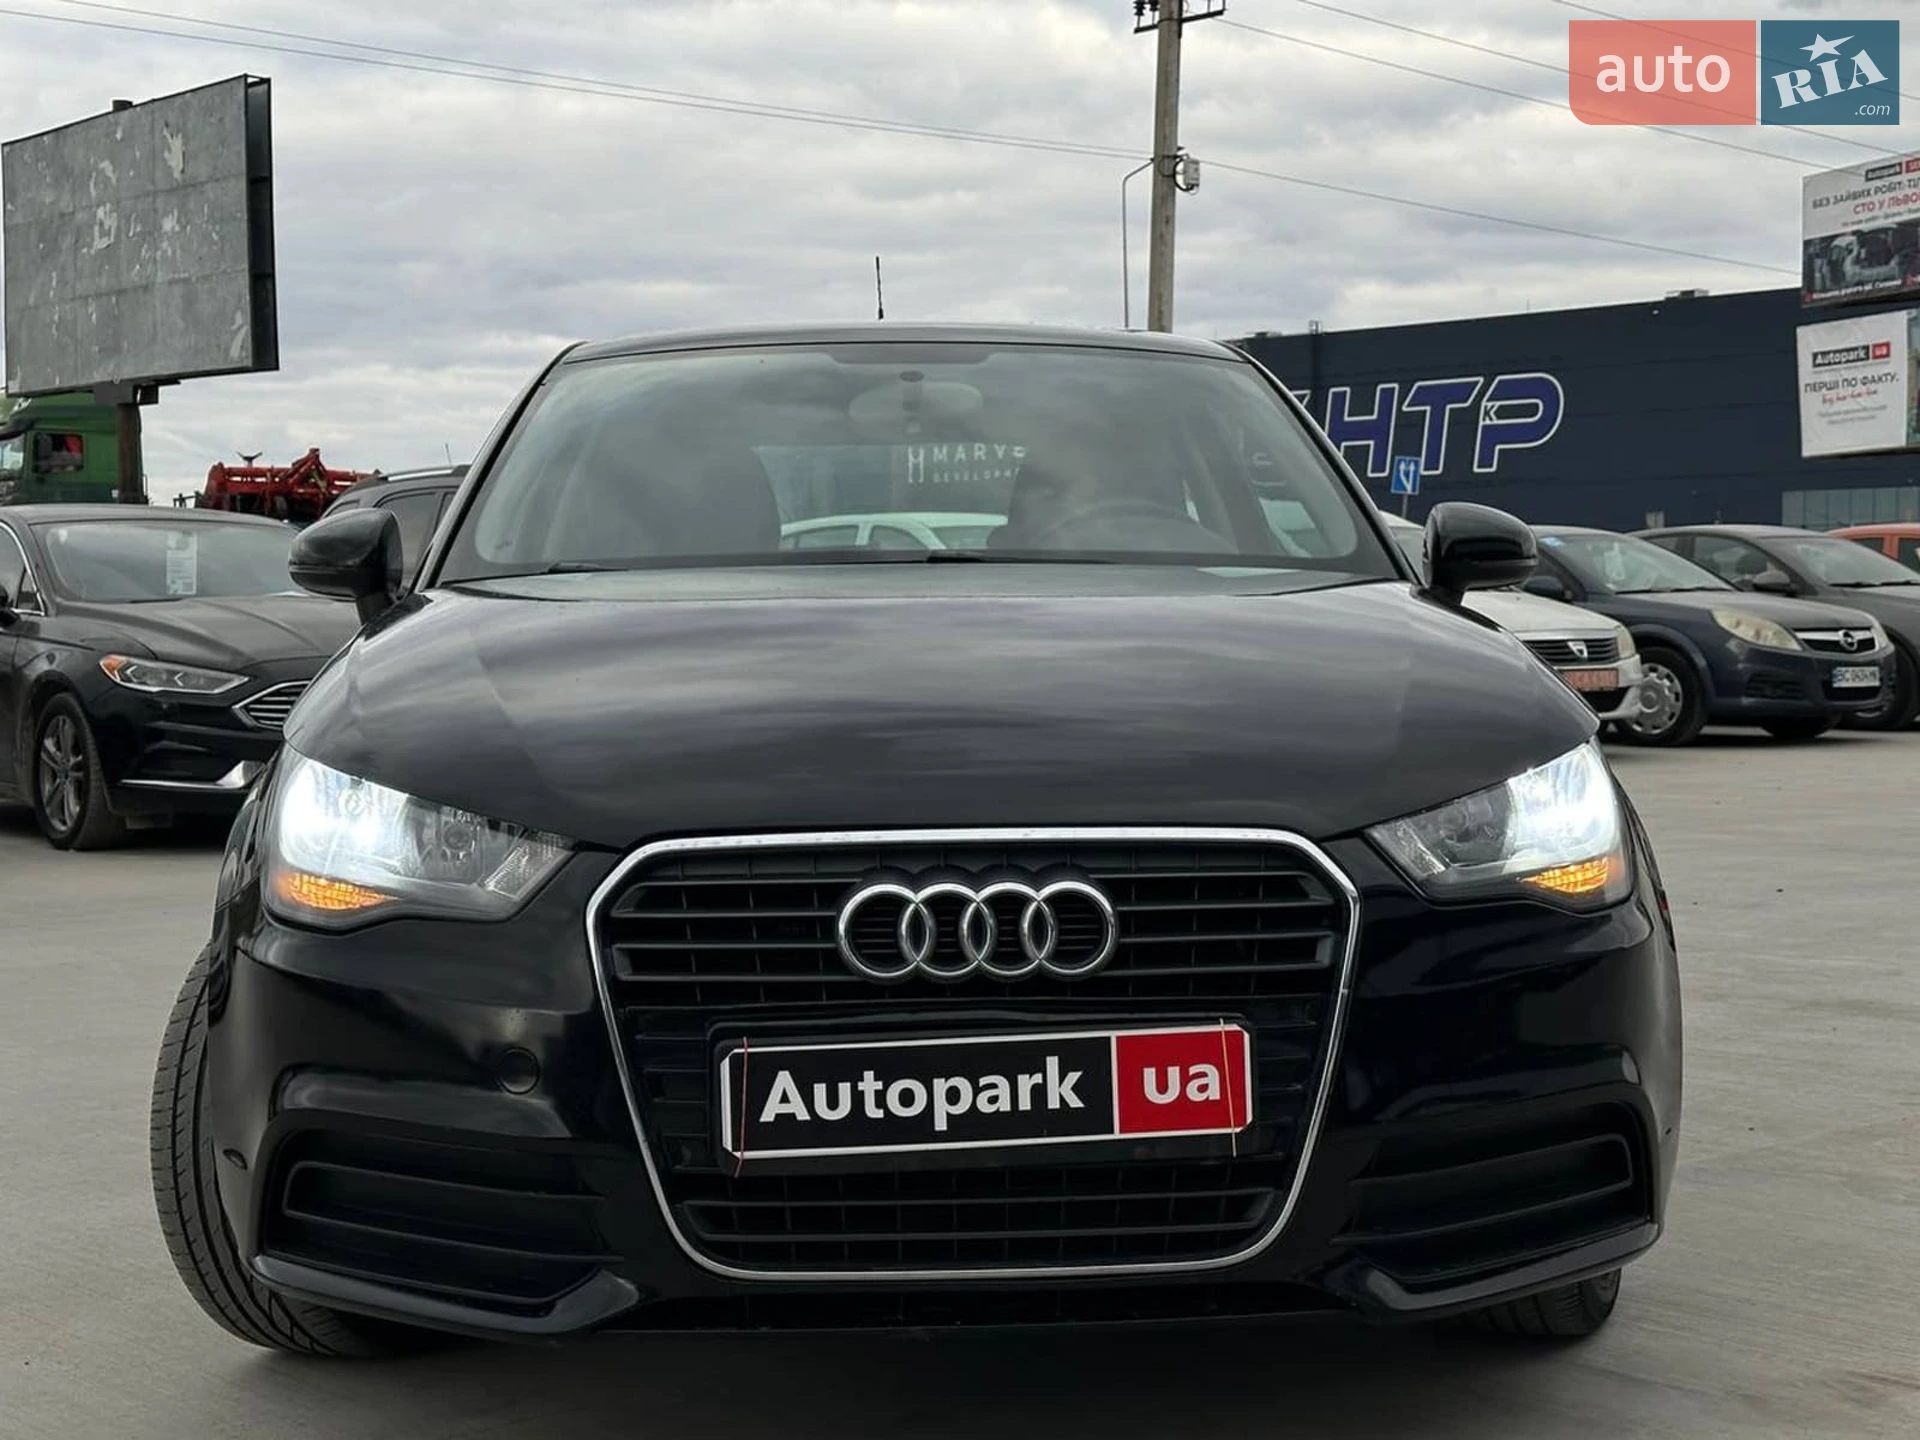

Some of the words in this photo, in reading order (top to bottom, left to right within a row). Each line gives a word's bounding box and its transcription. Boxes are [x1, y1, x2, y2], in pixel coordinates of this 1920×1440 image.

[1813, 197, 1830, 209] БЕЗ
[1853, 200, 1876, 215] СТО
[1878, 199, 1885, 210] У
[1815, 348, 1867, 364] Autopark
[1805, 380, 1839, 393] ПЕРШІ
[1842, 377, 1858, 388] ПО
[1292, 372, 1564, 477] НТР
[759, 1055, 1085, 1131] Autopark
[1143, 1062, 1221, 1105] ua
